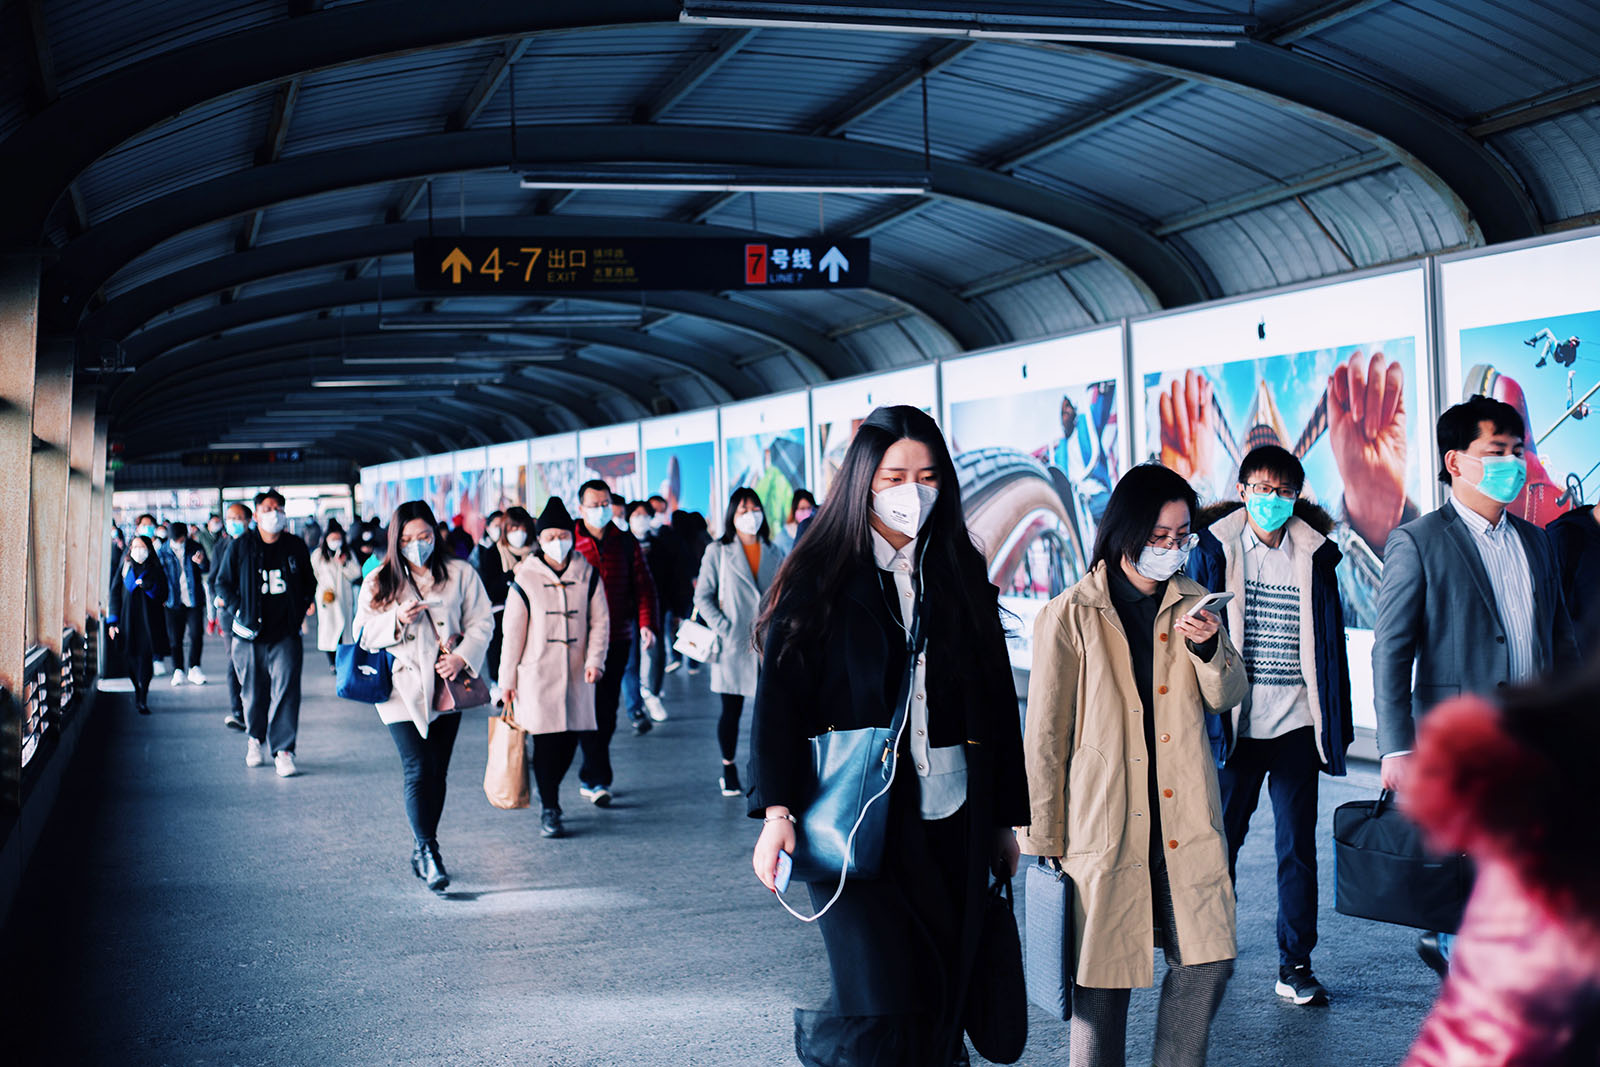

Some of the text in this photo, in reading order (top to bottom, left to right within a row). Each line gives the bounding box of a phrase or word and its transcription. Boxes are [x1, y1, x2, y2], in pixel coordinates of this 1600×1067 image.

[479, 247, 587, 282] 4~7 出口
[748, 248, 813, 276] 7 号线
[547, 271, 577, 282] EXIT
